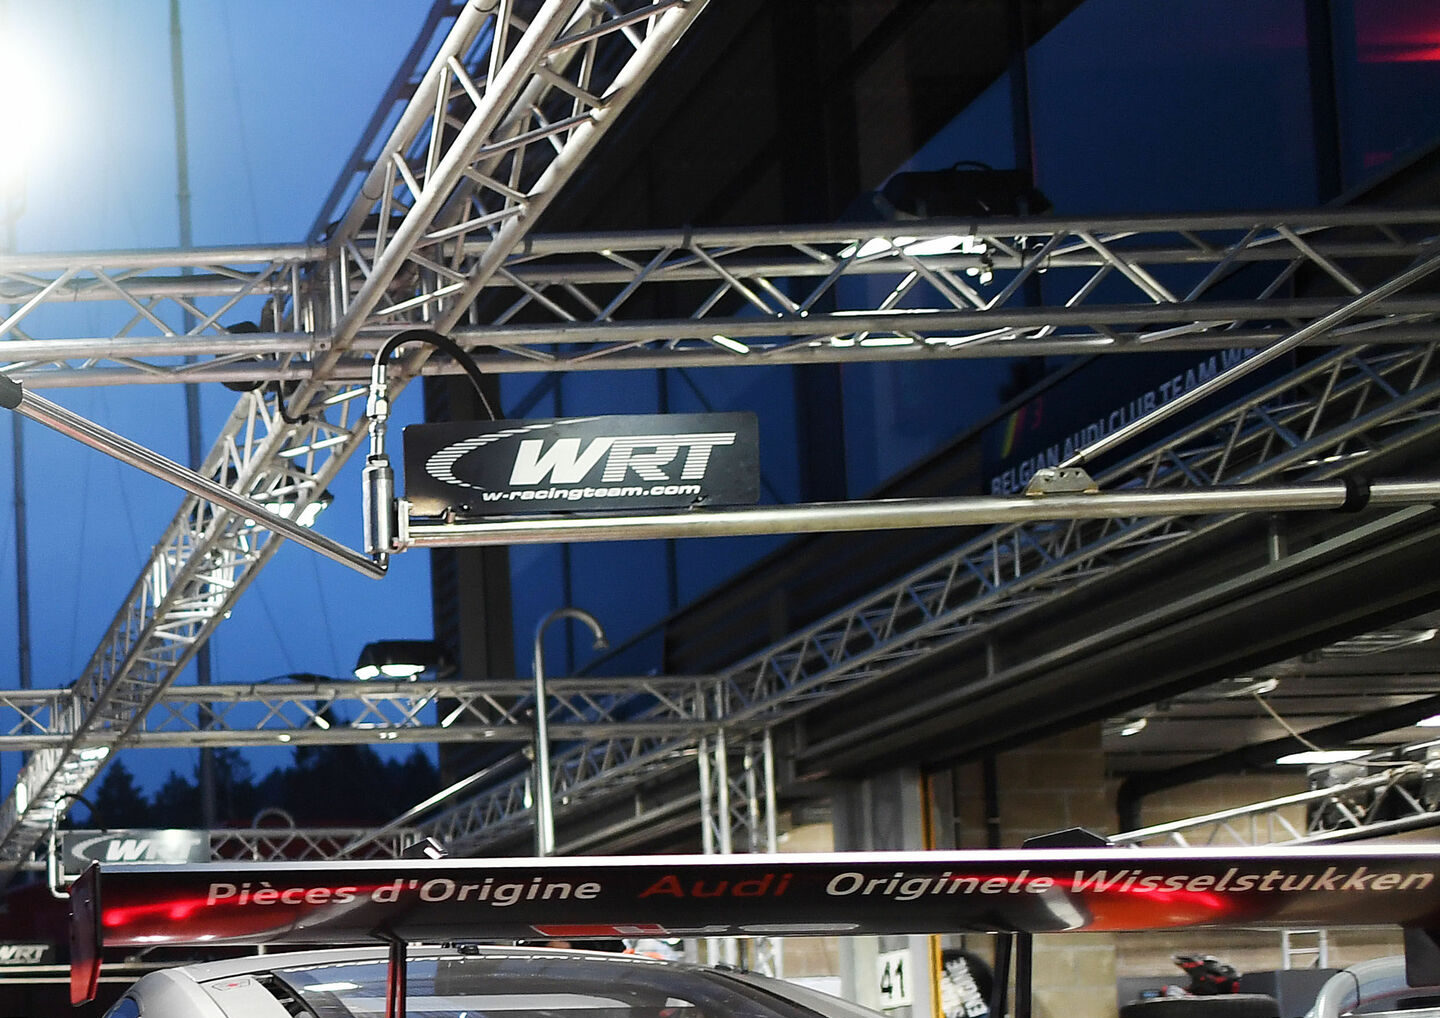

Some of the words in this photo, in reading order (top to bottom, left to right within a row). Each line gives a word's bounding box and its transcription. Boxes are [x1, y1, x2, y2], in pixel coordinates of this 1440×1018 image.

[991, 443, 1060, 496] BELGIAN
[1063, 417, 1105, 459] AUDI
[1108, 389, 1157, 434] CLUB
[1159, 355, 1218, 399] TEAM
[509, 432, 736, 485] WRT
[481, 483, 701, 502] w-racingteam.com
[206, 881, 356, 906] Pièces
[370, 877, 603, 907] d'Origine
[637, 871, 794, 900] Audi
[825, 870, 1056, 900] Originele
[1069, 868, 1434, 894] Wisselstukken
[880, 959, 905, 999] 41
